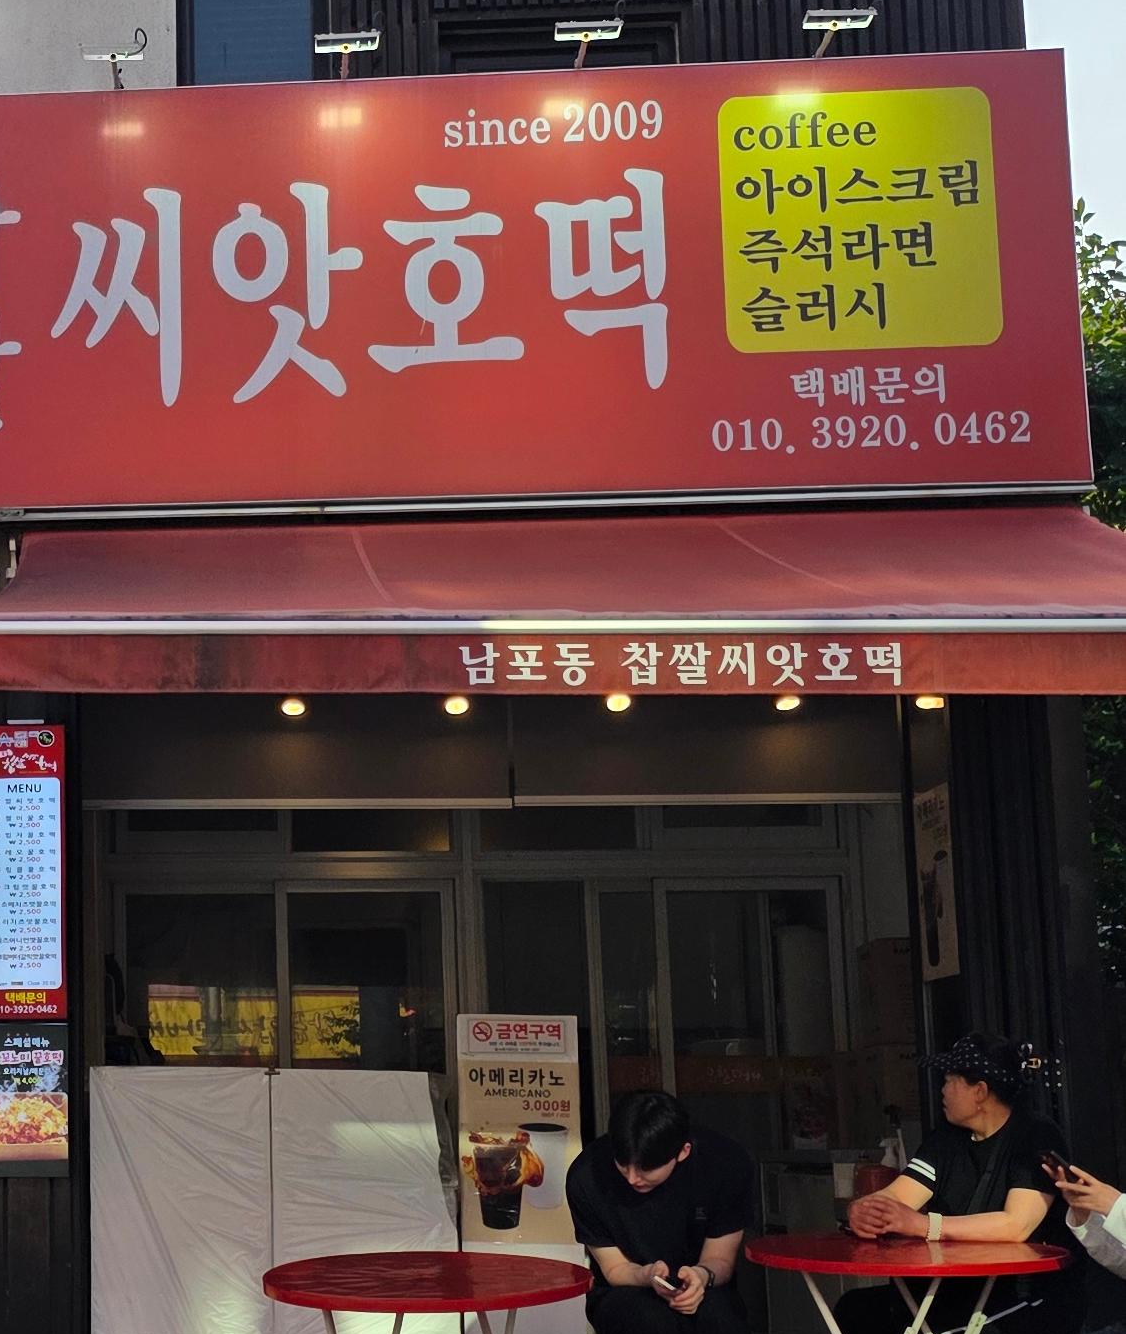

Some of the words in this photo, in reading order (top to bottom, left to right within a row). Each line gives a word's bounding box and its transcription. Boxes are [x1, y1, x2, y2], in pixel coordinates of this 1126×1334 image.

[442, 108, 551, 148] since
[562, 99, 664, 144] 2009
[732, 110, 878, 152] coffee
[734, 159, 981, 216] 아이스크림
[738, 221, 938, 275] 즉석라면
[50, 166, 669, 407] 씨앗호떡
[740, 281, 889, 333] 슬러시
[789, 363, 947, 408] 택배문의
[711, 418, 796, 455] 010.
[810, 413, 920, 451] 3920.
[933, 409, 1032, 445] 0462
[458, 642, 595, 687] 남포동
[620, 641, 904, 688] 찹쌀씨앗호떡
[7, 783, 42, 794] MENU
[5, 991, 47, 1004] 택배문의
[495, 1022, 562, 1041] 금연구역
[468, 1067, 566, 1088] 아메리카노
[483, 1088, 552, 1099] AMERICANO
